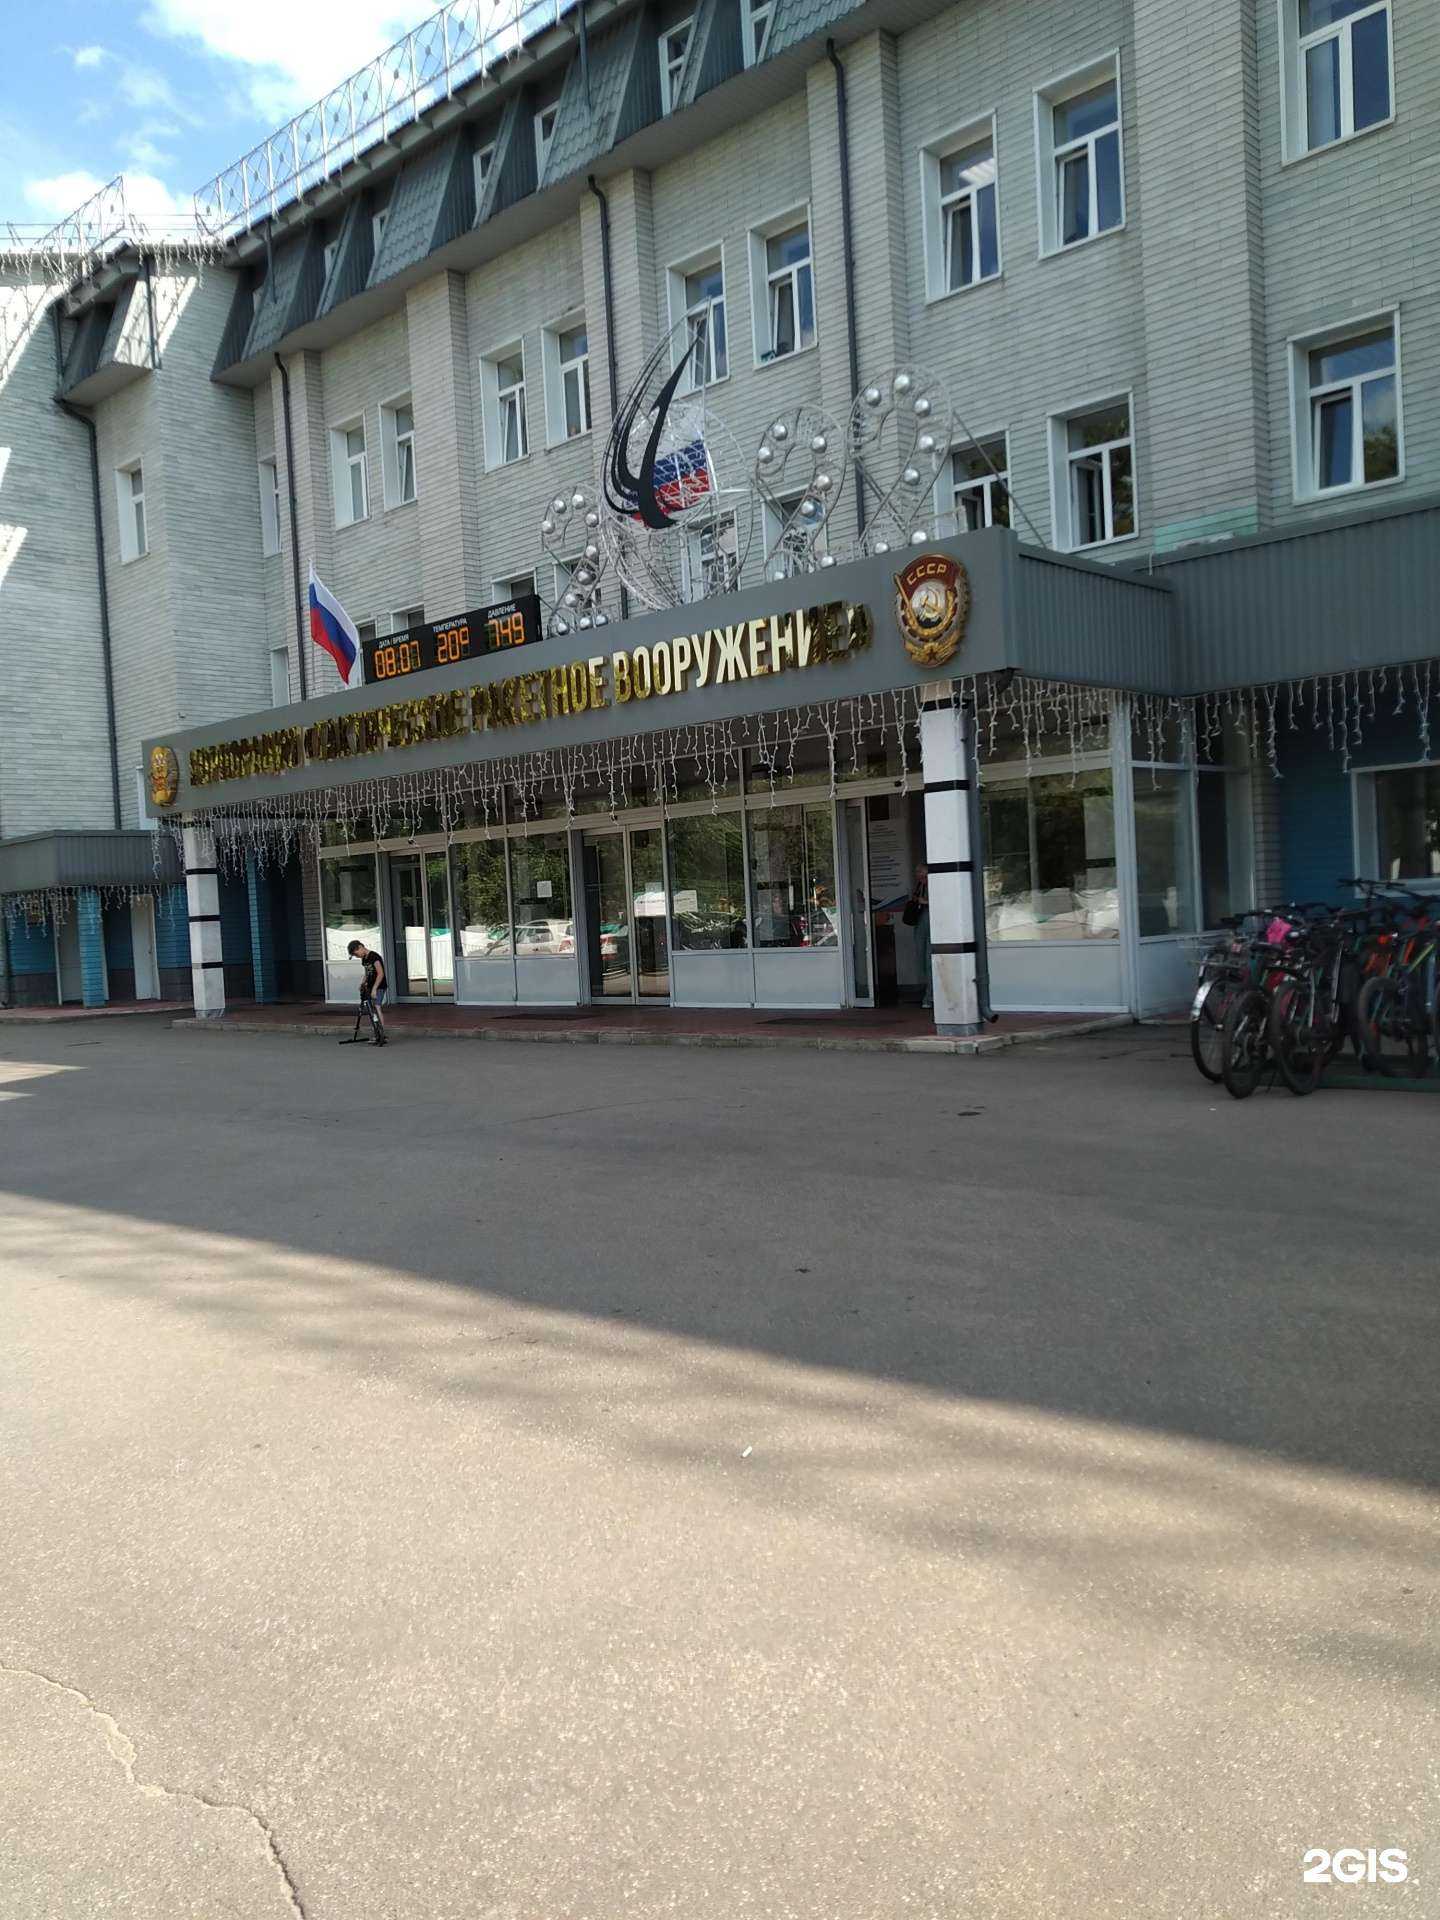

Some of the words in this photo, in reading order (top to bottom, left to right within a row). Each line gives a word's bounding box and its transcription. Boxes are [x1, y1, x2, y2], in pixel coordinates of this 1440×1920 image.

[906, 563, 947, 585] СССР
[487, 611, 526, 648] 749
[374, 640, 422, 679] 08.07
[470, 656, 607, 733] РАКЕТНОЕ
